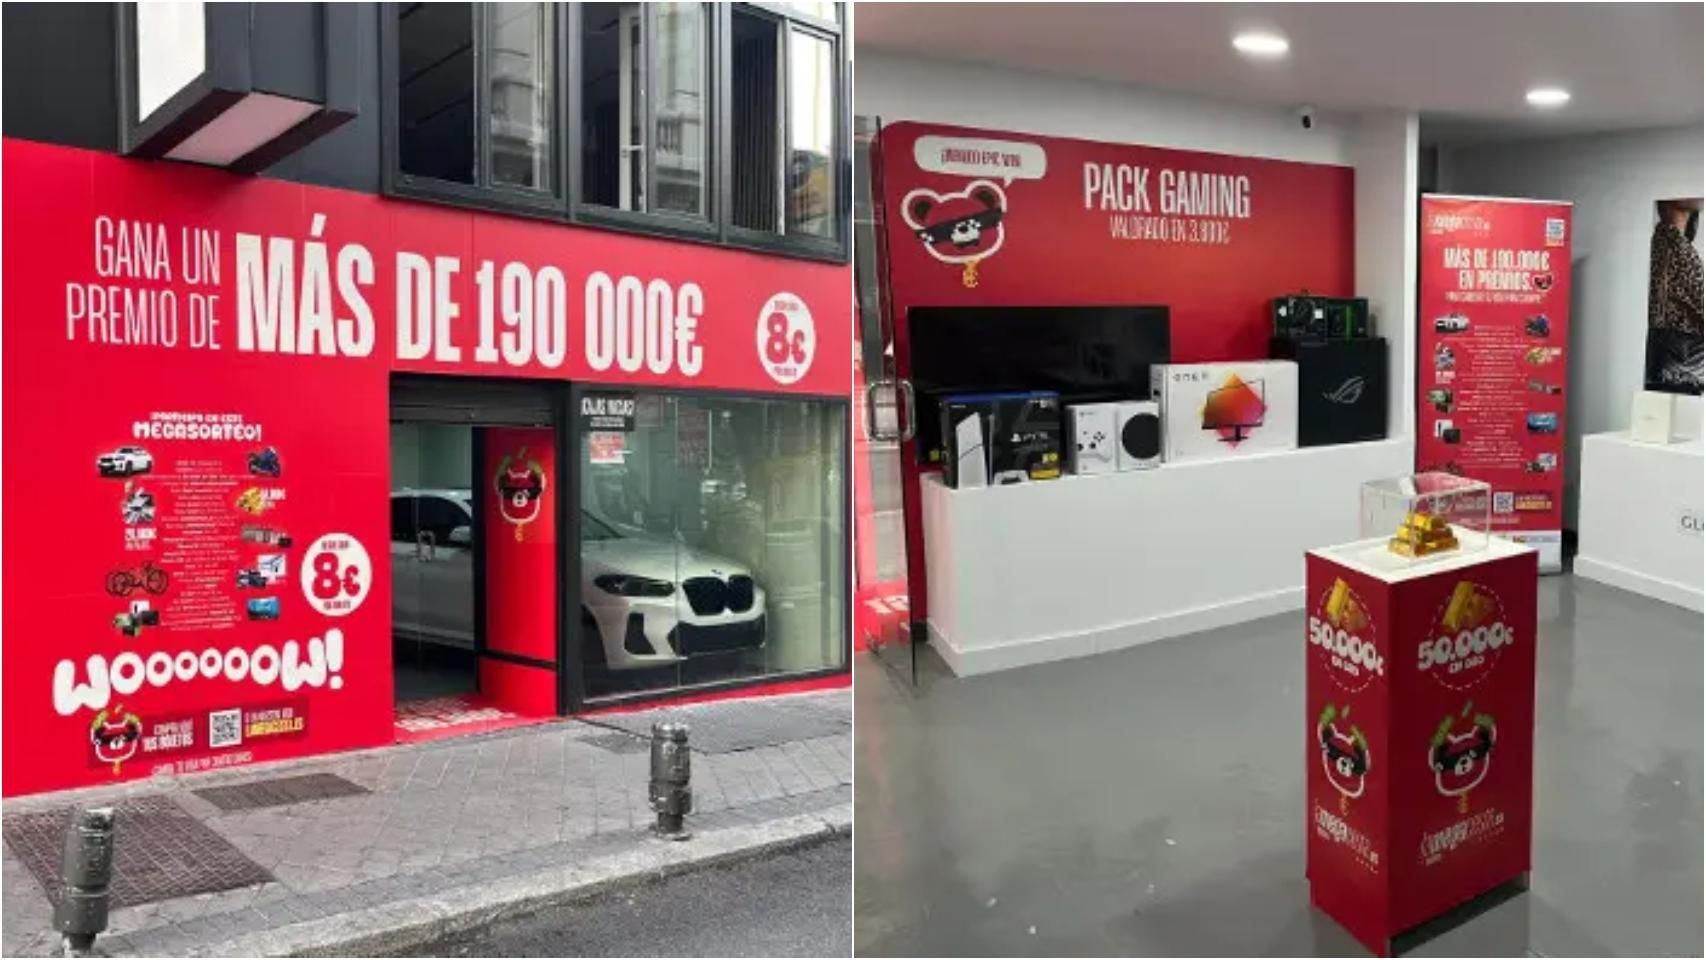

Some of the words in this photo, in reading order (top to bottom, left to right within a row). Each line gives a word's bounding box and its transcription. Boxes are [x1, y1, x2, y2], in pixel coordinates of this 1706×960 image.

[1083, 162, 1152, 213] PACK
[1160, 168, 1250, 218] GAMING
[95, 216, 171, 281] GANA
[182, 226, 220, 285] UN
[1444, 243, 1470, 269] MÁS
[1474, 247, 1489, 269] DE
[235, 212, 376, 359] MÁS
[395, 251, 461, 362] DE
[474, 260, 567, 369] 190
[584, 270, 704, 377] 000€
[1459, 269, 1475, 290] EN
[66, 283, 178, 349] PREMIO
[189, 294, 221, 351] DE
[765, 312, 806, 364] 8€
[133, 420, 262, 441] MEGASORTEO!
[312, 552, 361, 599] 8€
[53, 628, 344, 716] WOOOOOOW!
